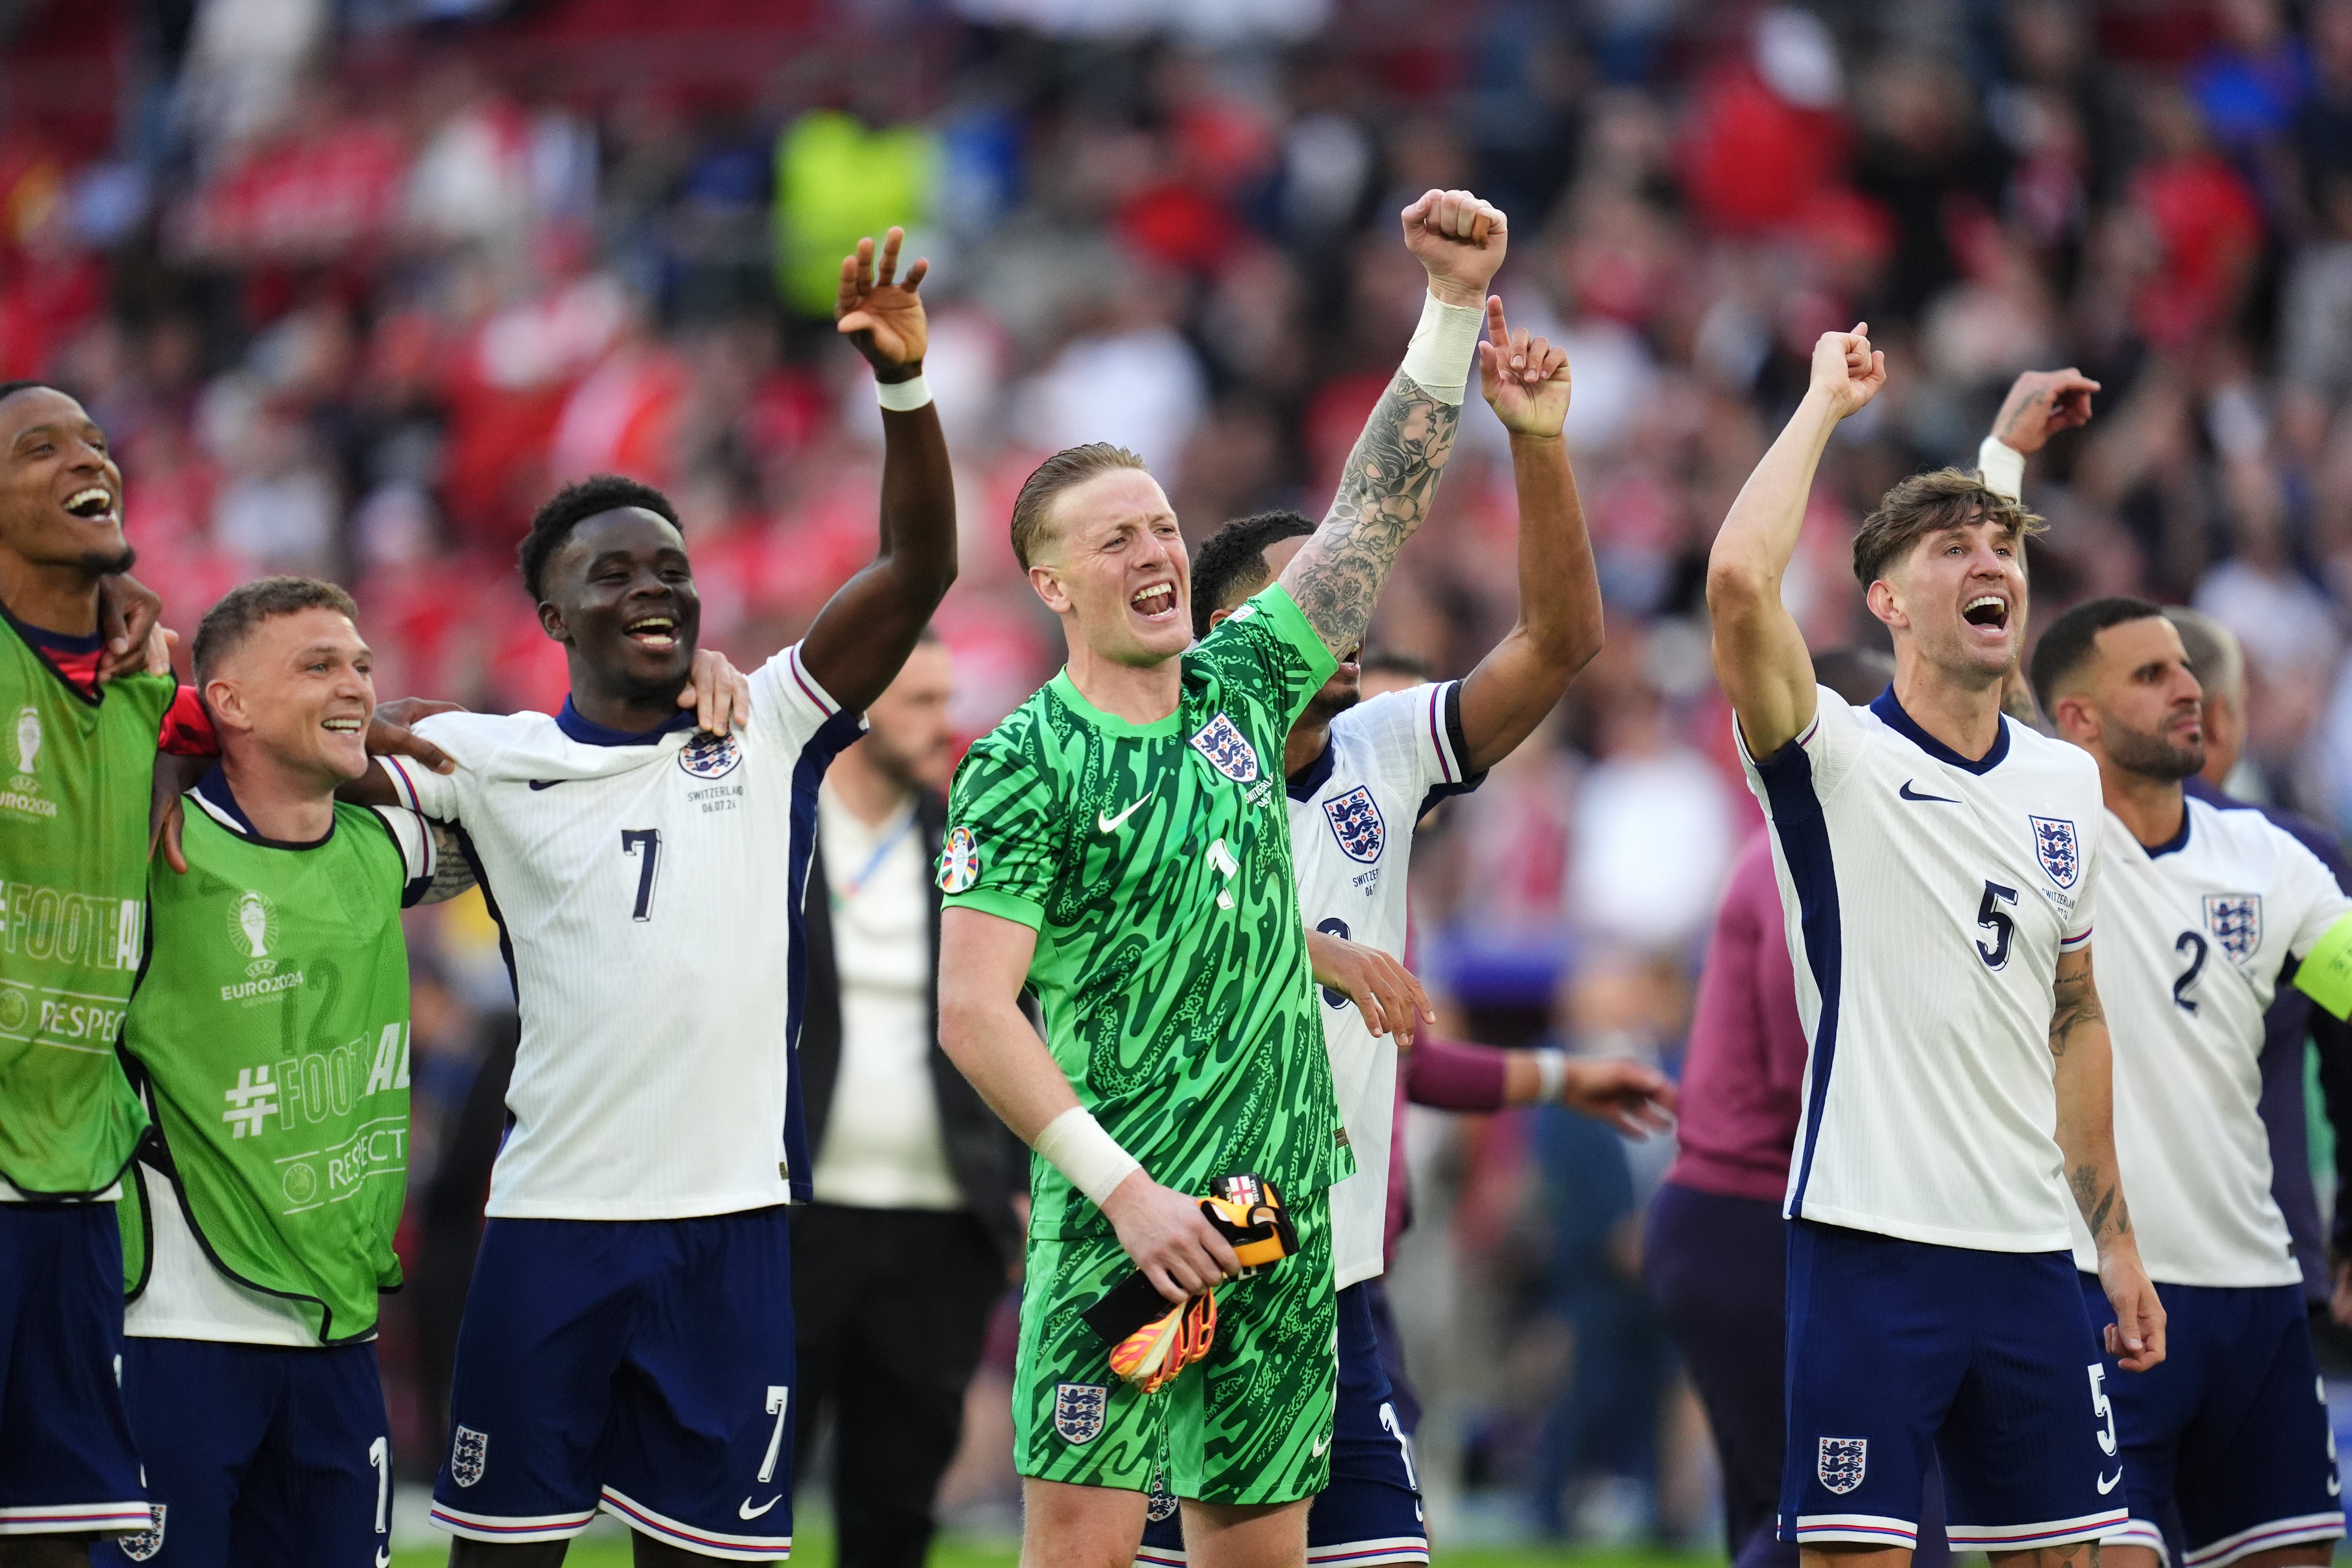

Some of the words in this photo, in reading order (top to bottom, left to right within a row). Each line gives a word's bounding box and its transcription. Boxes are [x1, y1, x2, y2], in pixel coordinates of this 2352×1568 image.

[621, 828, 661, 922] 7
[1206, 837, 1240, 910] 1
[1976, 879, 2019, 971] 5
[220, 970, 305, 1000] EURO2024
[2173, 931, 2209, 1018] 2
[757, 1385, 788, 1483] 7
[2087, 1362, 2117, 1457] 5
[369, 1436, 392, 1534] 1
